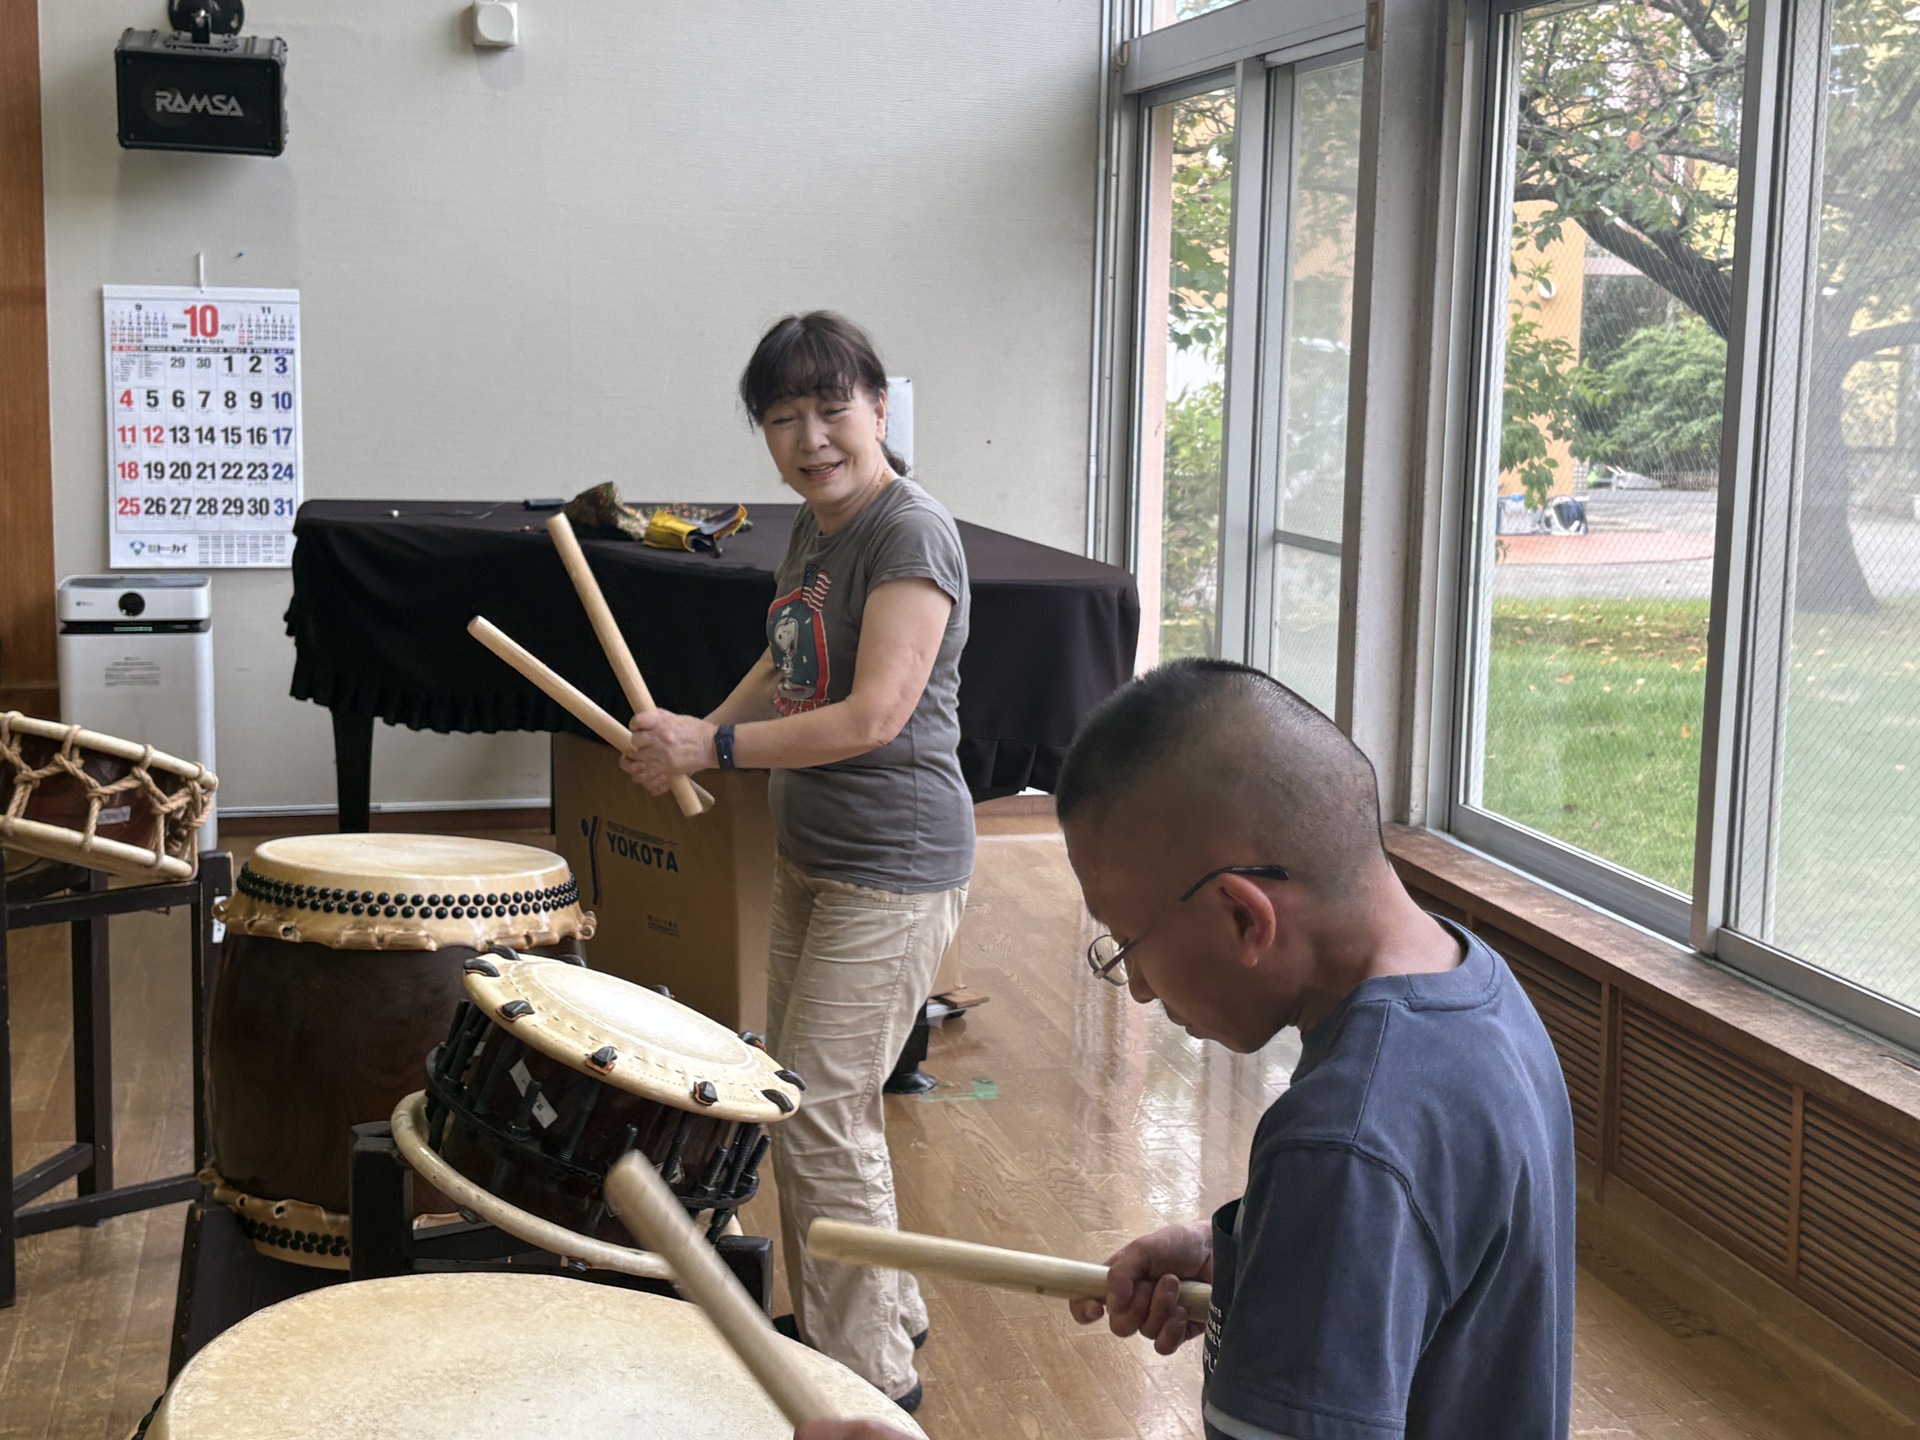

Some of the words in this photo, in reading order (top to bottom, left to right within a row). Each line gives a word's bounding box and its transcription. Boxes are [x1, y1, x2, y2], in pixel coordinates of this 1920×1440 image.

[155, 90, 245, 117] RAMSA
[260, 305, 271, 315] 11
[183, 304, 219, 338] 10
[170, 356, 186, 369] 29
[196, 356, 212, 369] 30
[222, 355, 234, 373] 1
[248, 355, 262, 374] 2
[274, 355, 288, 375] 3
[119, 389, 133, 407] 4
[146, 389, 160, 408] 5
[172, 389, 186, 408] 6
[198, 390, 211, 408] 7
[224, 390, 237, 409] 8
[249, 390, 263, 410] 9
[271, 391, 293, 411] 10
[118, 425, 136, 443] 11
[143, 425, 164, 444] 12
[168, 425, 190, 444] 13
[194, 426, 216, 444] 14
[220, 426, 242, 445] 15
[246, 426, 268, 445] 16
[272, 427, 293, 445] 17
[117, 461, 139, 480] 18
[143, 461, 165, 480] 19
[169, 461, 192, 480] 20
[195, 461, 216, 480] 21
[220, 461, 244, 481] 22
[246, 462, 269, 481] 23
[271, 462, 294, 481] 24
[117, 497, 141, 516] 25
[143, 497, 167, 516] 26
[170, 497, 192, 516] 27
[195, 497, 219, 516] 28
[221, 497, 245, 516] 29
[247, 497, 270, 516] 30
[273, 497, 295, 517] 31
[606, 831, 679, 873] YOKOTA
